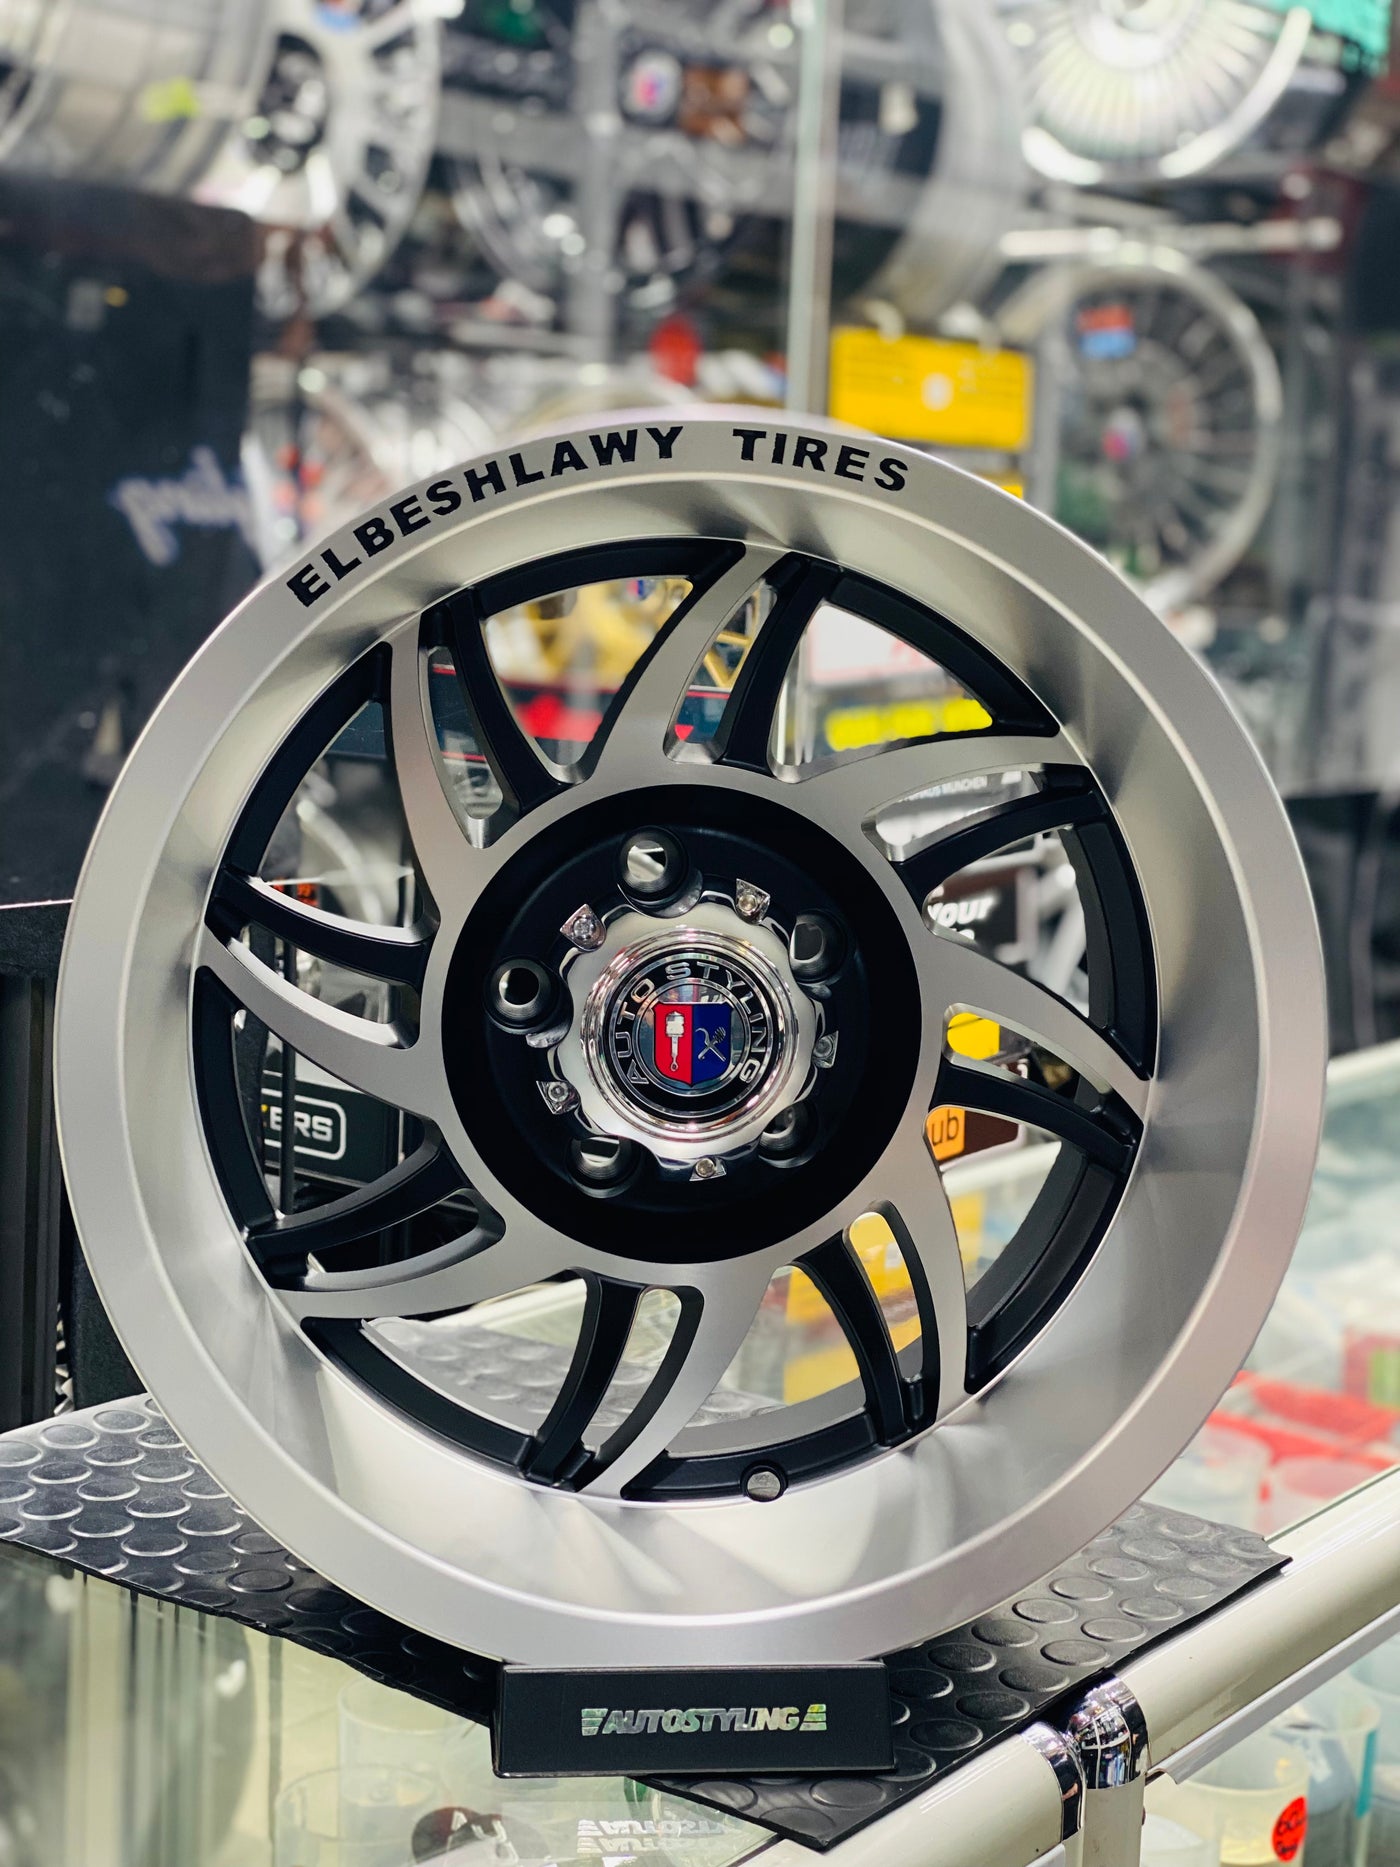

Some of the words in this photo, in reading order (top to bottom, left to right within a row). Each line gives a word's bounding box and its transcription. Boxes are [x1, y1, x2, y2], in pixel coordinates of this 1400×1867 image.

[286, 426, 684, 607] ELBESHLAWY
[732, 428, 910, 492] TIRES
[615, 978, 656, 1086] AUTO
[665, 960, 767, 1084] STYLING
[261, 1103, 334, 1143] ERS
[602, 1706, 800, 1735] AUTOSTYLING
